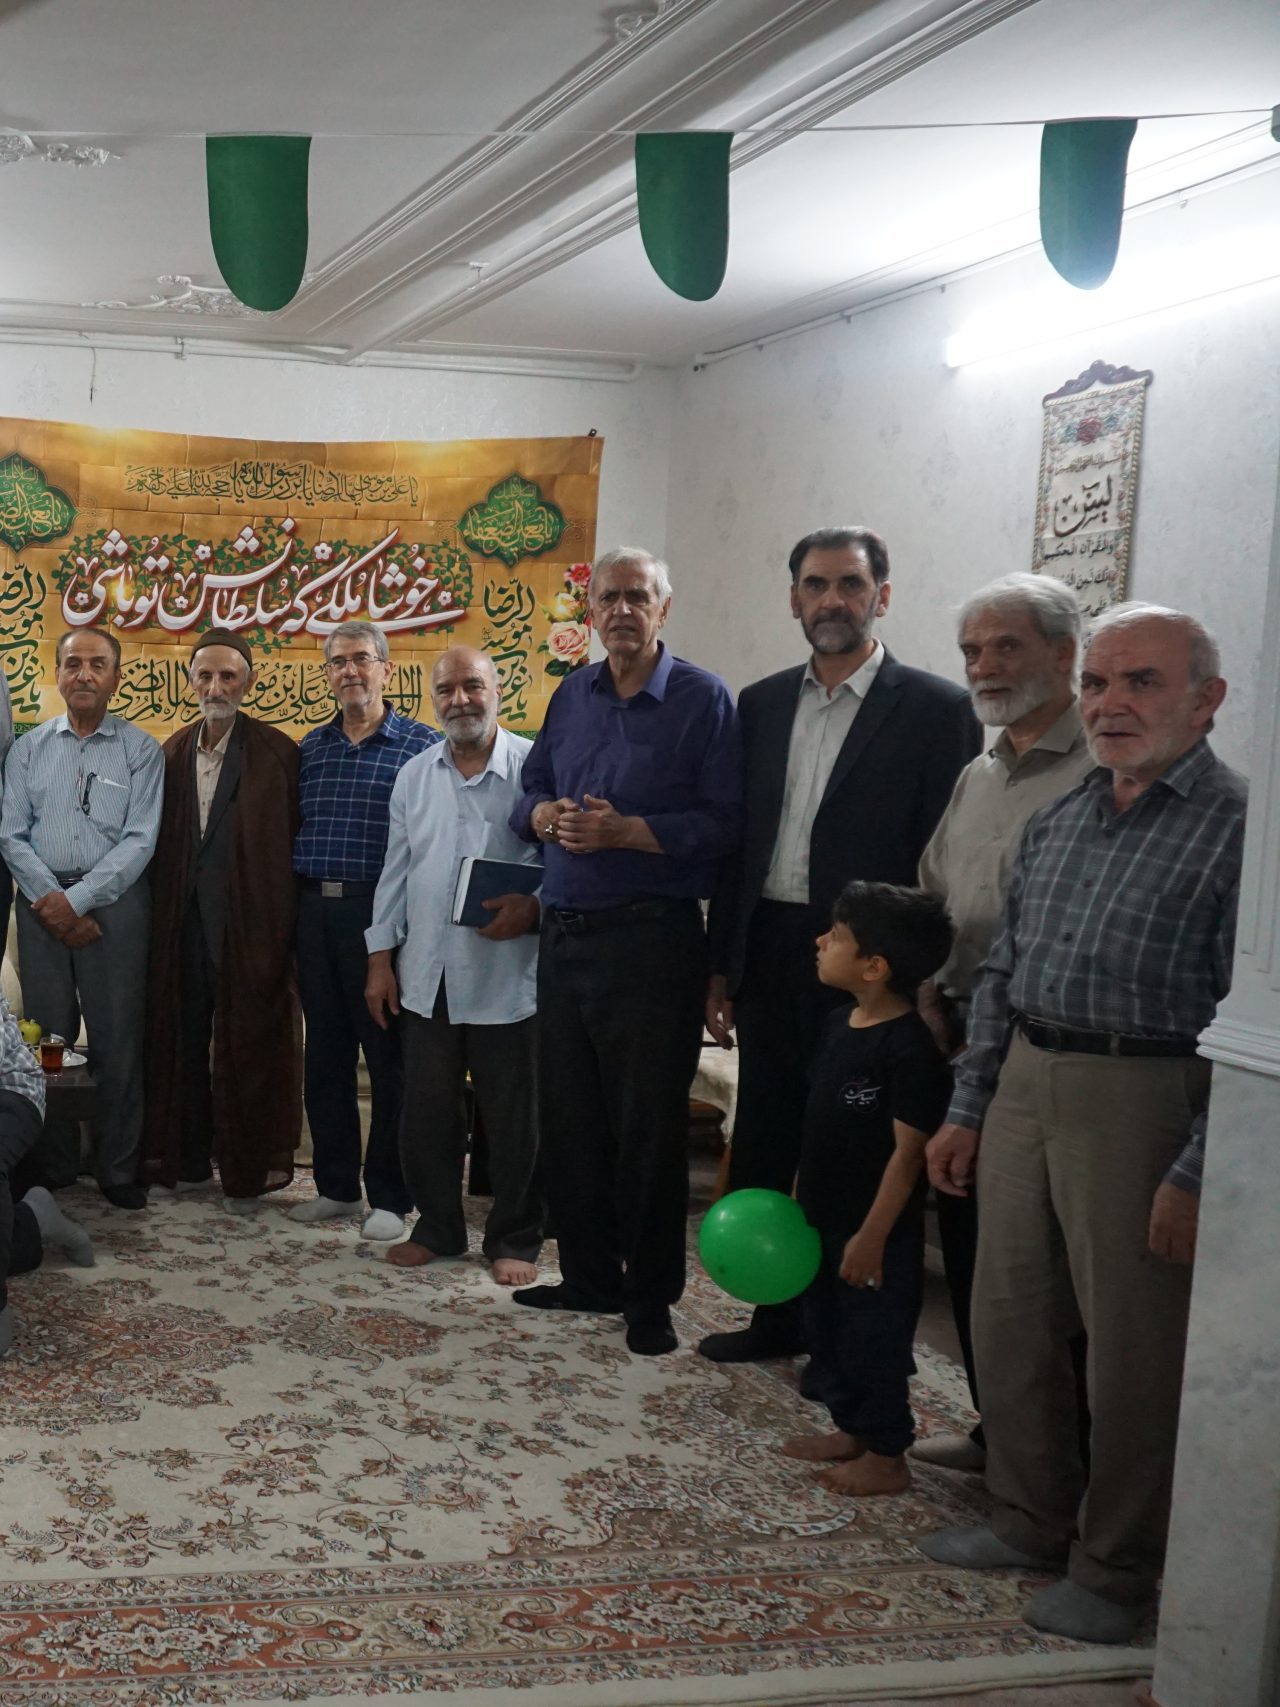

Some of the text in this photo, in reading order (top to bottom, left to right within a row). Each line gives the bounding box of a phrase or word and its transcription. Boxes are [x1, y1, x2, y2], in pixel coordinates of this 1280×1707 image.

[157, 517, 293, 632] سلطانش
[277, 555, 352, 635] که
[368, 555, 439, 621] خوشا
[483, 578, 536, 629] الرضا
